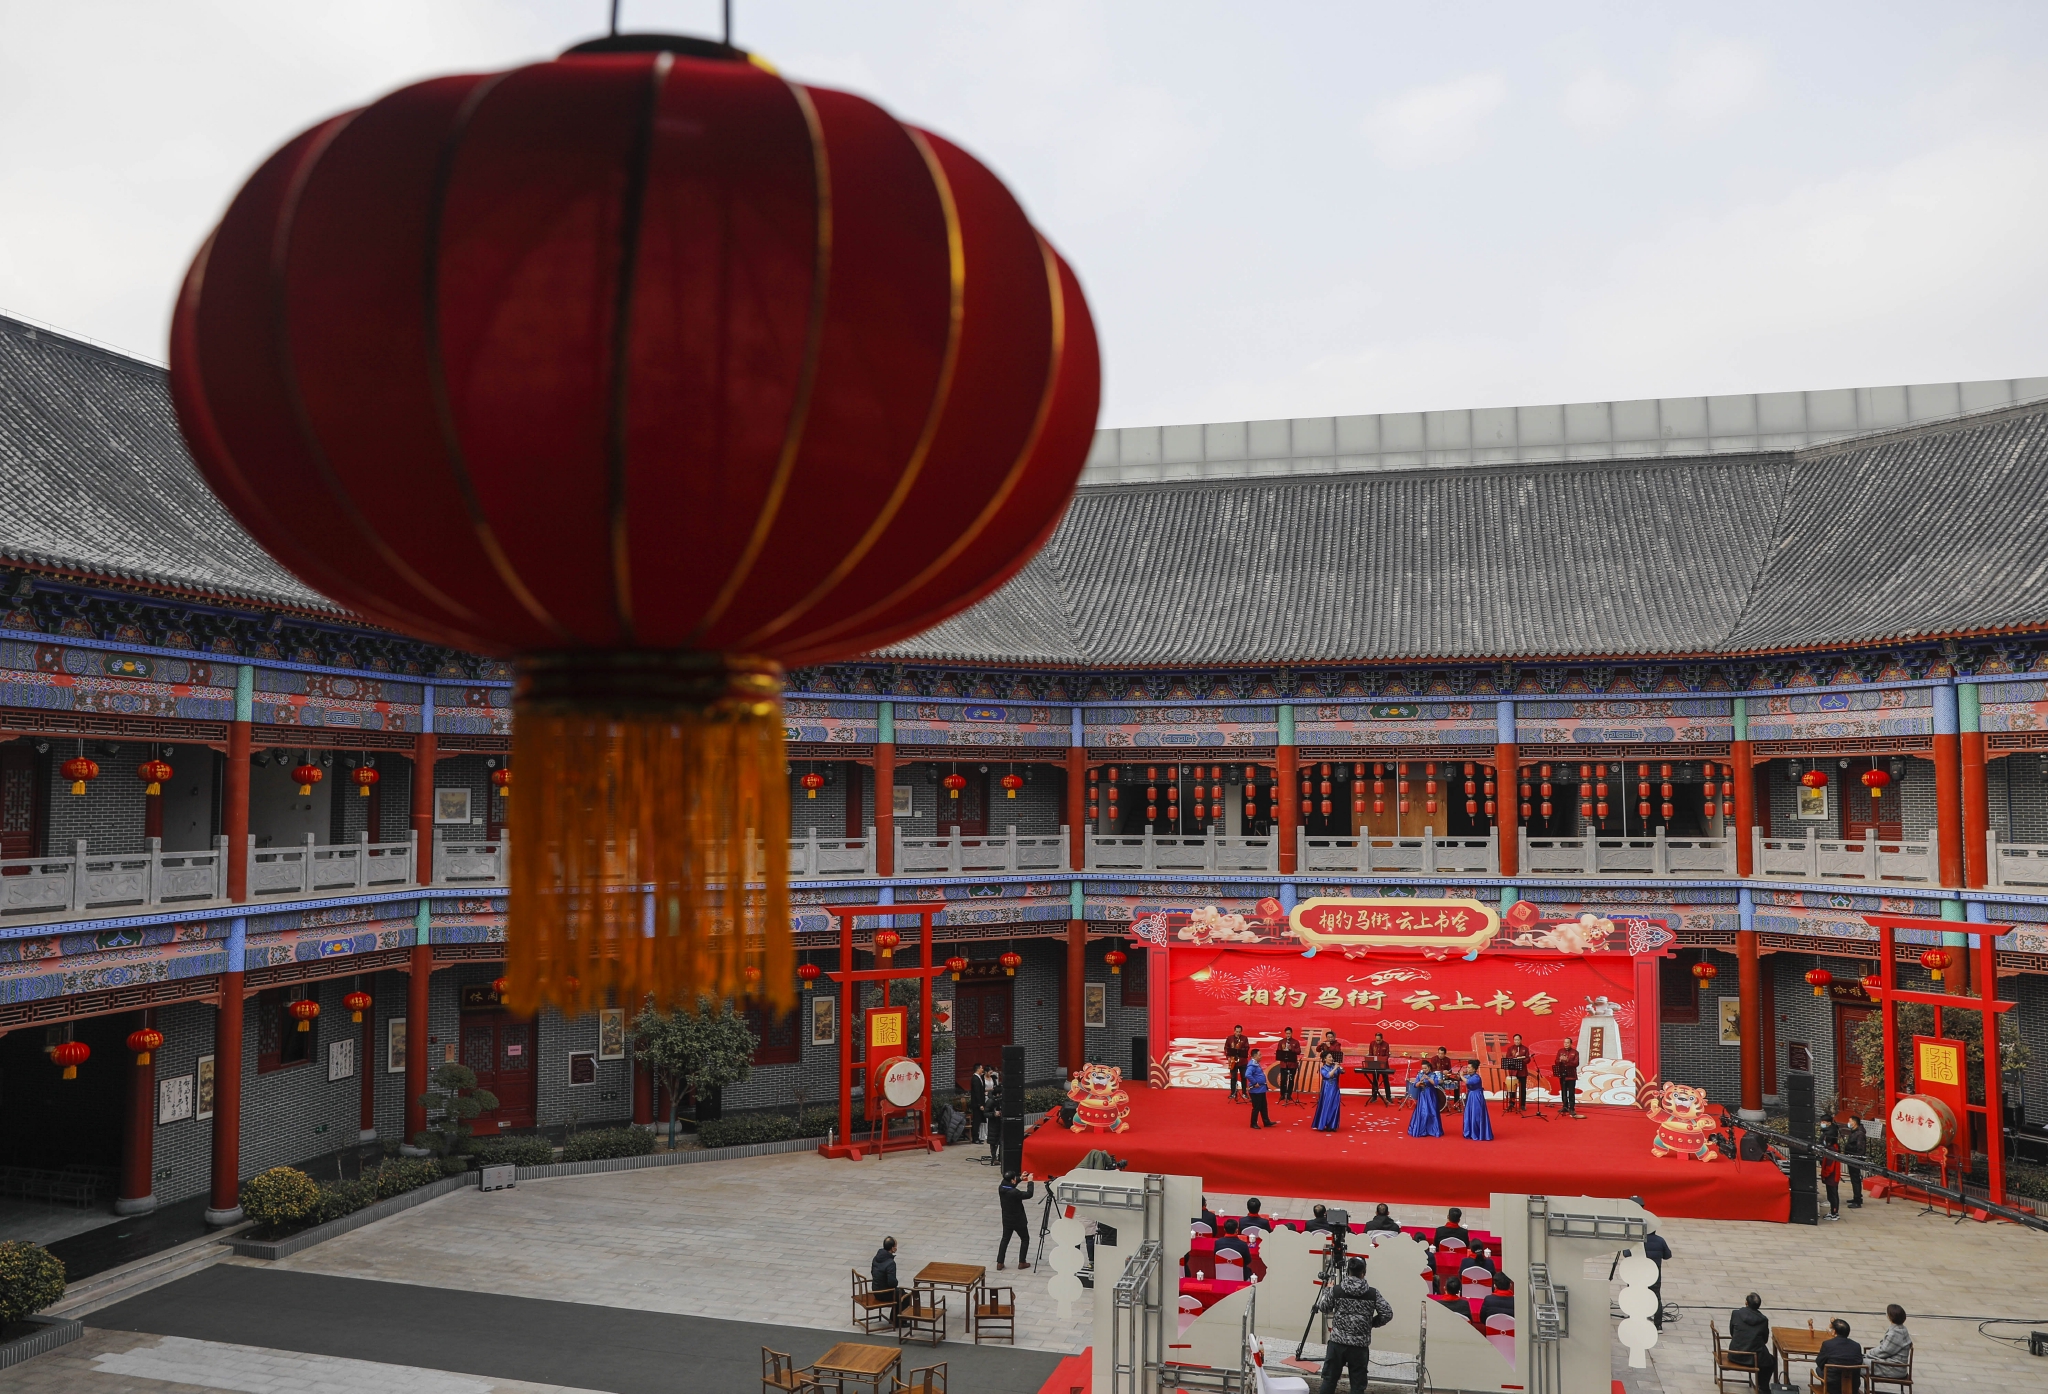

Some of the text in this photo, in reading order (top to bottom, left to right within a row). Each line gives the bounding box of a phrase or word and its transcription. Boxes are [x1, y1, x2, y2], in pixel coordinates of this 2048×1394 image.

[1318, 909, 1470, 932] 相约马街 云上书会
[1237, 985, 1558, 1016] 相约马街 云上书会
